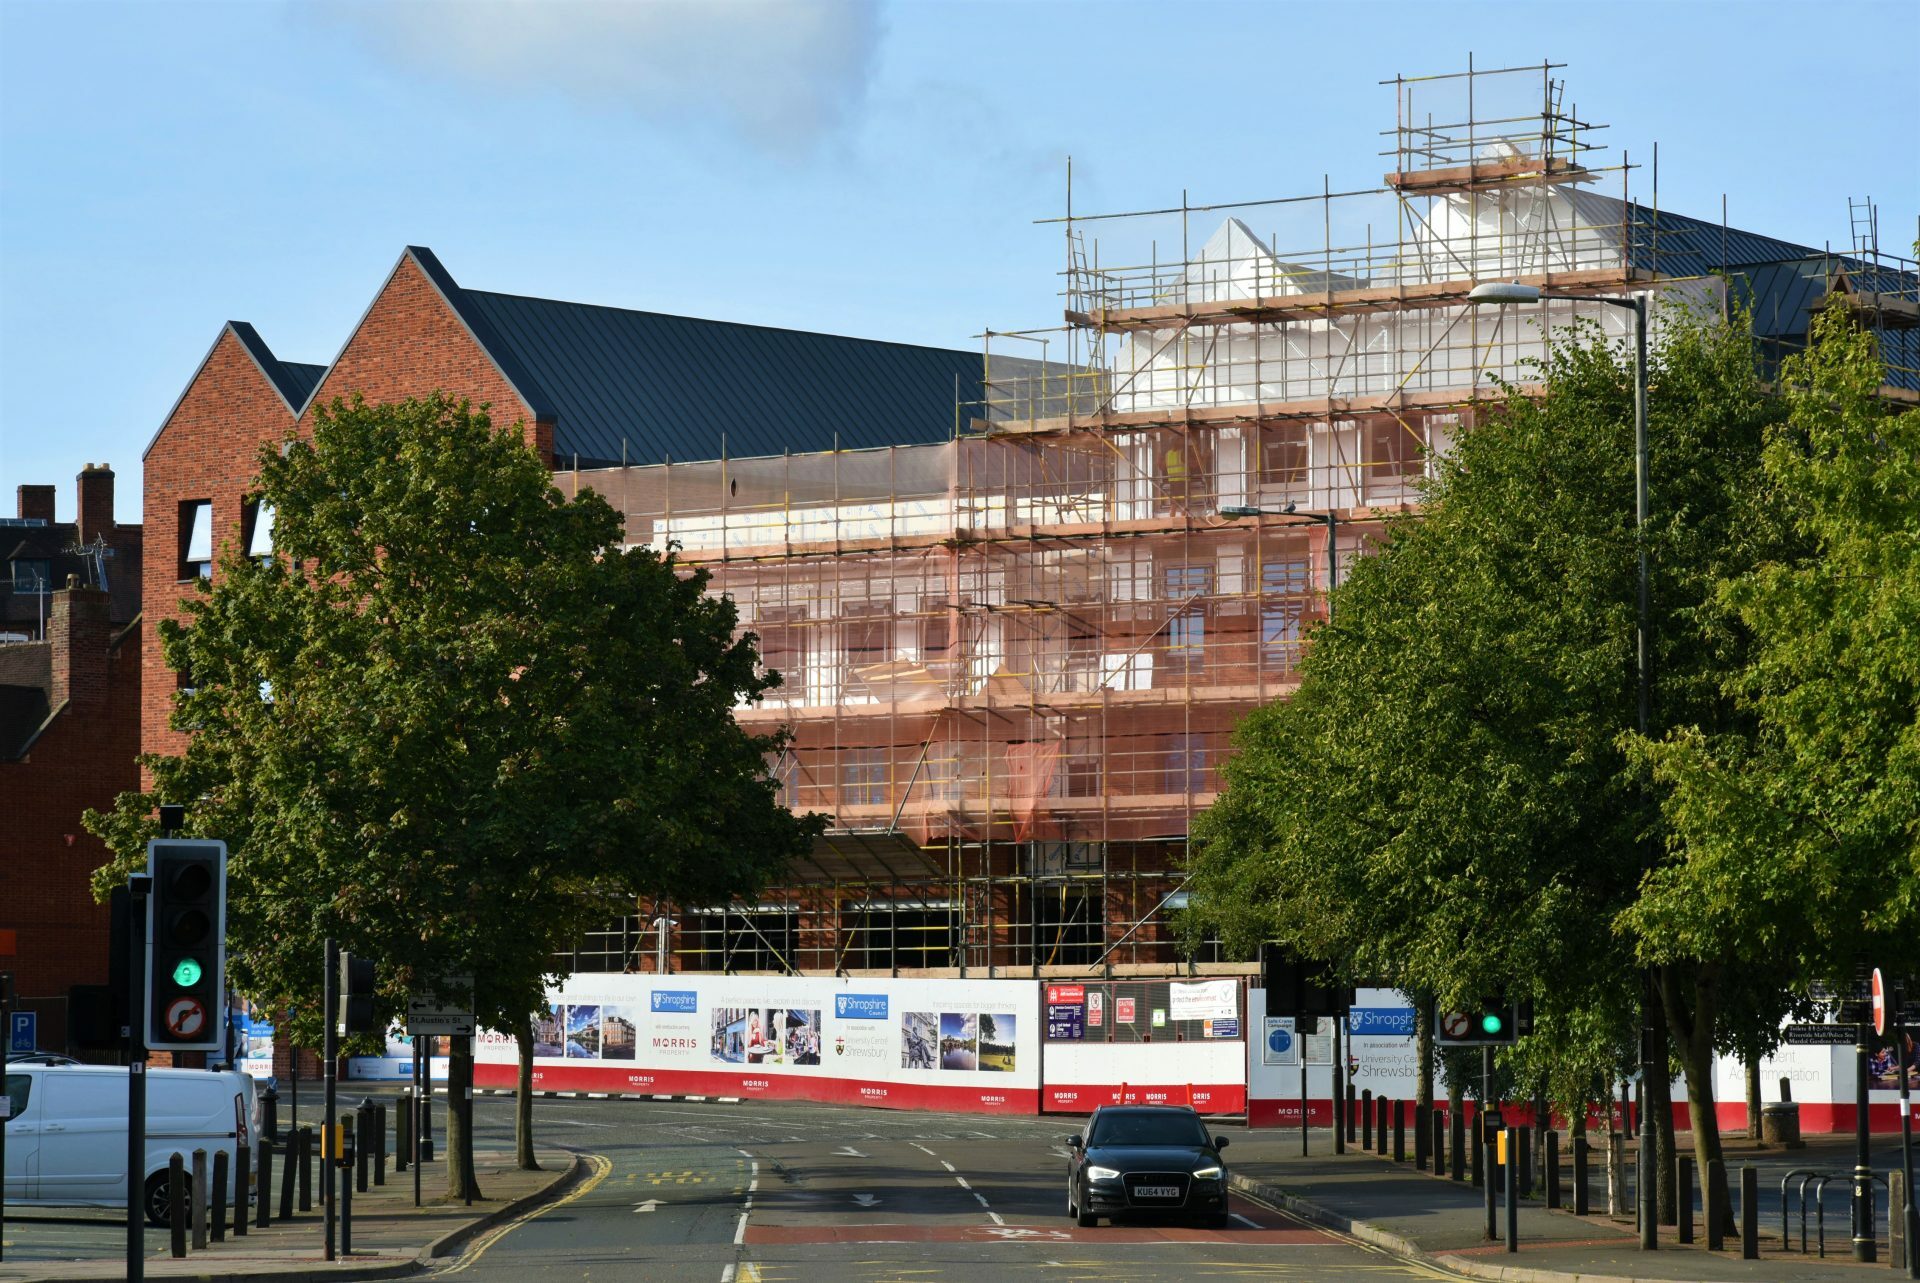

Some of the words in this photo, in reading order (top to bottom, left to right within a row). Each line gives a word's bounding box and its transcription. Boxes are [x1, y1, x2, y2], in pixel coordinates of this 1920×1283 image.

[662, 993, 696, 1007] Shropshire
[847, 996, 887, 1013] Shropshire
[17, 1017, 29, 1033] P
[1364, 1011, 1412, 1029] Shropsh
[652, 1038, 697, 1049] MORRIS
[845, 1045, 888, 1059] Shrewsbury
[1361, 1054, 1403, 1066] University
[1362, 1064, 1418, 1078] Shrewsbu
[1729, 1066, 1820, 1081] Acmmodation
[629, 1075, 654, 1083] MORRIS
[742, 1080, 769, 1088] MORRIS
[860, 1087, 888, 1096] MORRIS
[981, 1095, 1005, 1103] MORRIS
[1137, 1187, 1158, 1196] KU64
[1160, 1187, 1176, 1196] VYG
